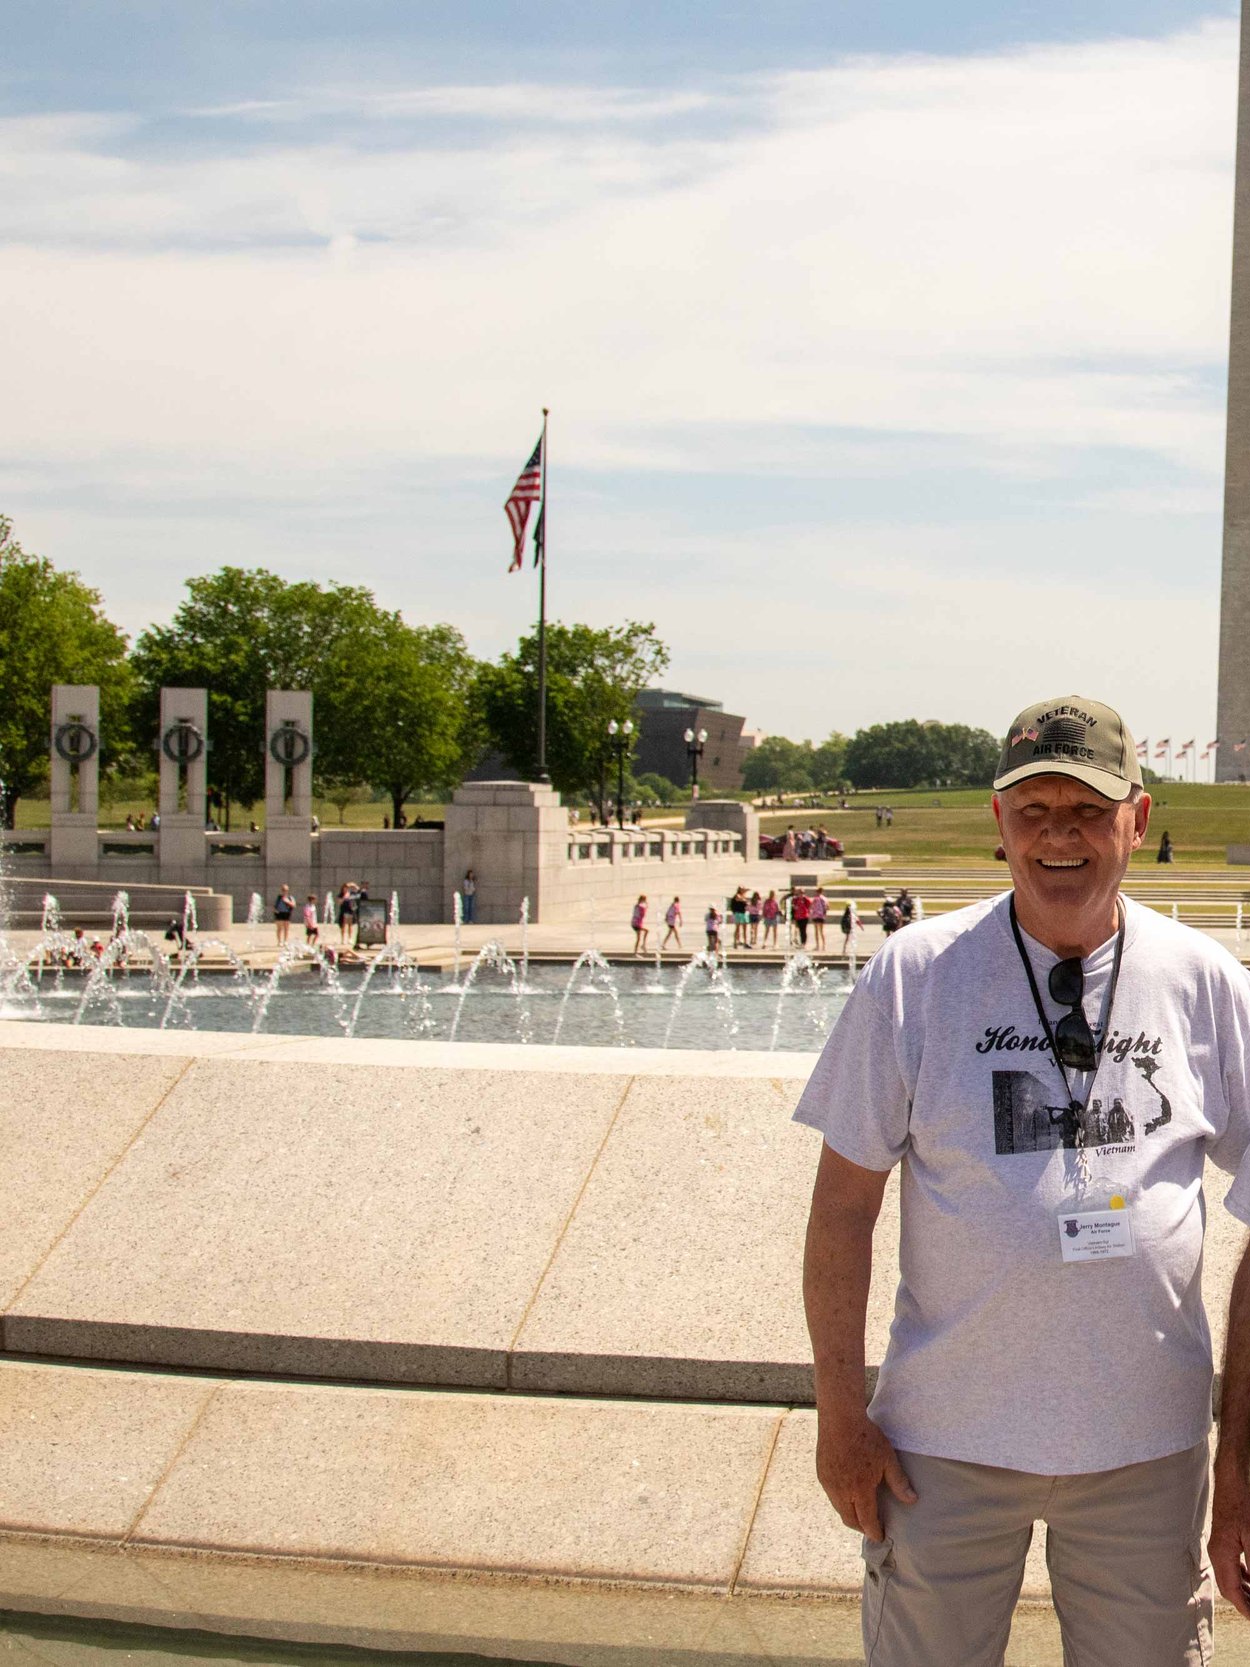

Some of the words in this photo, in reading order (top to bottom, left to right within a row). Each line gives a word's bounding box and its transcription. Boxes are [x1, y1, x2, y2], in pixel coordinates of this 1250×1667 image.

[1037, 706, 1097, 727] VETERAN
[1033, 744, 1051, 756] AIR
[1054, 743, 1095, 759] FORCE
[976, 1026, 1052, 1054] Hono
[1095, 1145, 1136, 1157] Vietnam
